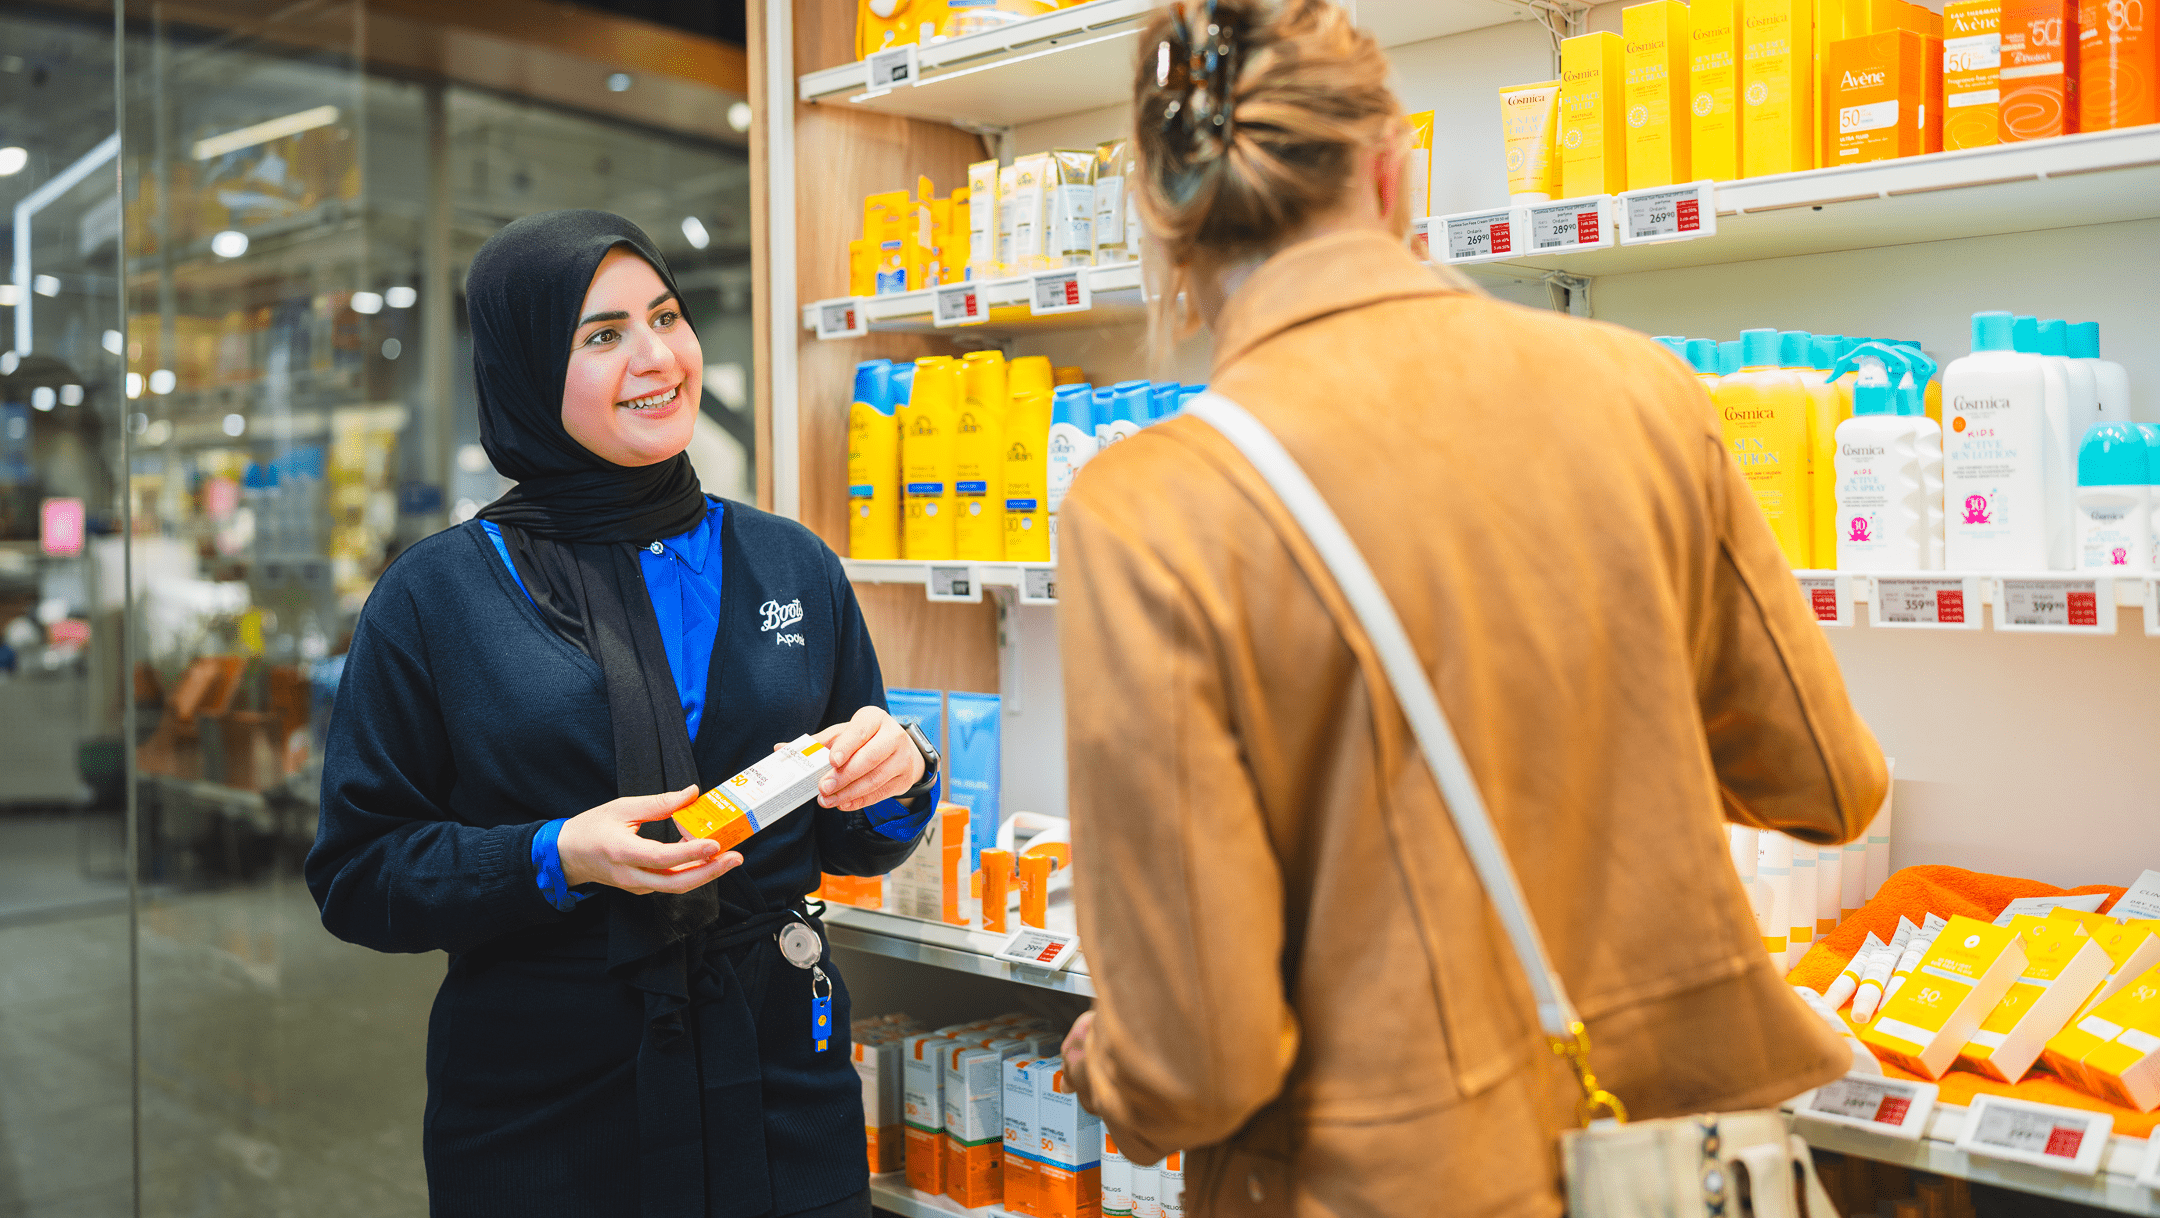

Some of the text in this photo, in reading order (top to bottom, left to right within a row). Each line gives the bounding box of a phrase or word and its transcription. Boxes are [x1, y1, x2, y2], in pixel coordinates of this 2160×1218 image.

[1746, 13, 1787, 28] Cosmica
[1693, 26, 1730, 40] Cosmica
[1626, 40, 1664, 54] Cosmica
[1564, 68, 1600, 82] Cosmica
[1840, 70, 1885, 88] Avène
[1508, 94, 1545, 106] Cosmica
[1954, 396, 2011, 412] Cosmica
[1724, 406, 1775, 421] Cosmica
[1968, 428, 1994, 438] KIDS
[1734, 438, 1764, 451] SUN
[1842, 444, 1885, 456] Cosmica
[1962, 440, 2002, 450] ACTIVE
[1732, 452, 1780, 465] OTION
[730, 774, 749, 787] 50
[1041, 1137, 1054, 1152] 50
